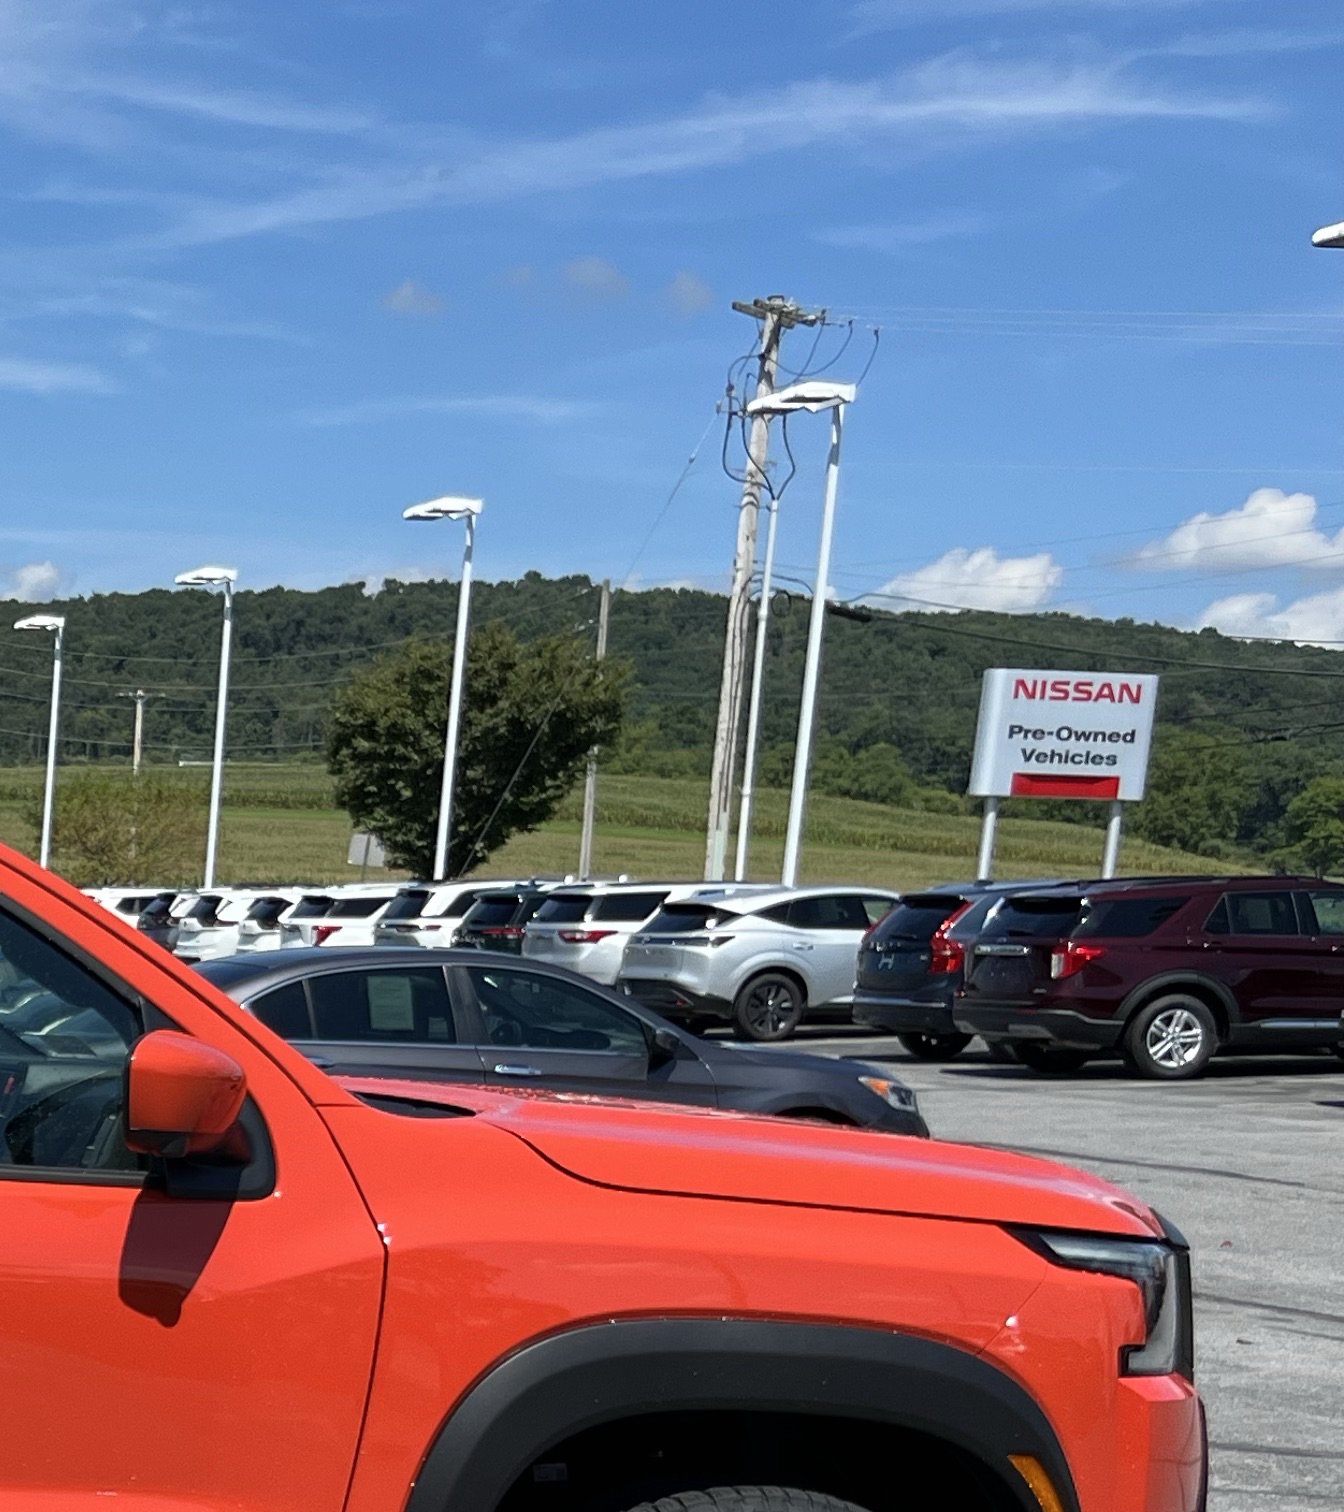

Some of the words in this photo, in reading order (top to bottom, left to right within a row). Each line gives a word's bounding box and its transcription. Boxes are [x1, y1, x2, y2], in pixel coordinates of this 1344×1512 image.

[1013, 678, 1142, 704] NISSAN
[1008, 724, 1137, 744] Pre-Owned
[1021, 747, 1118, 766] Vehicles
